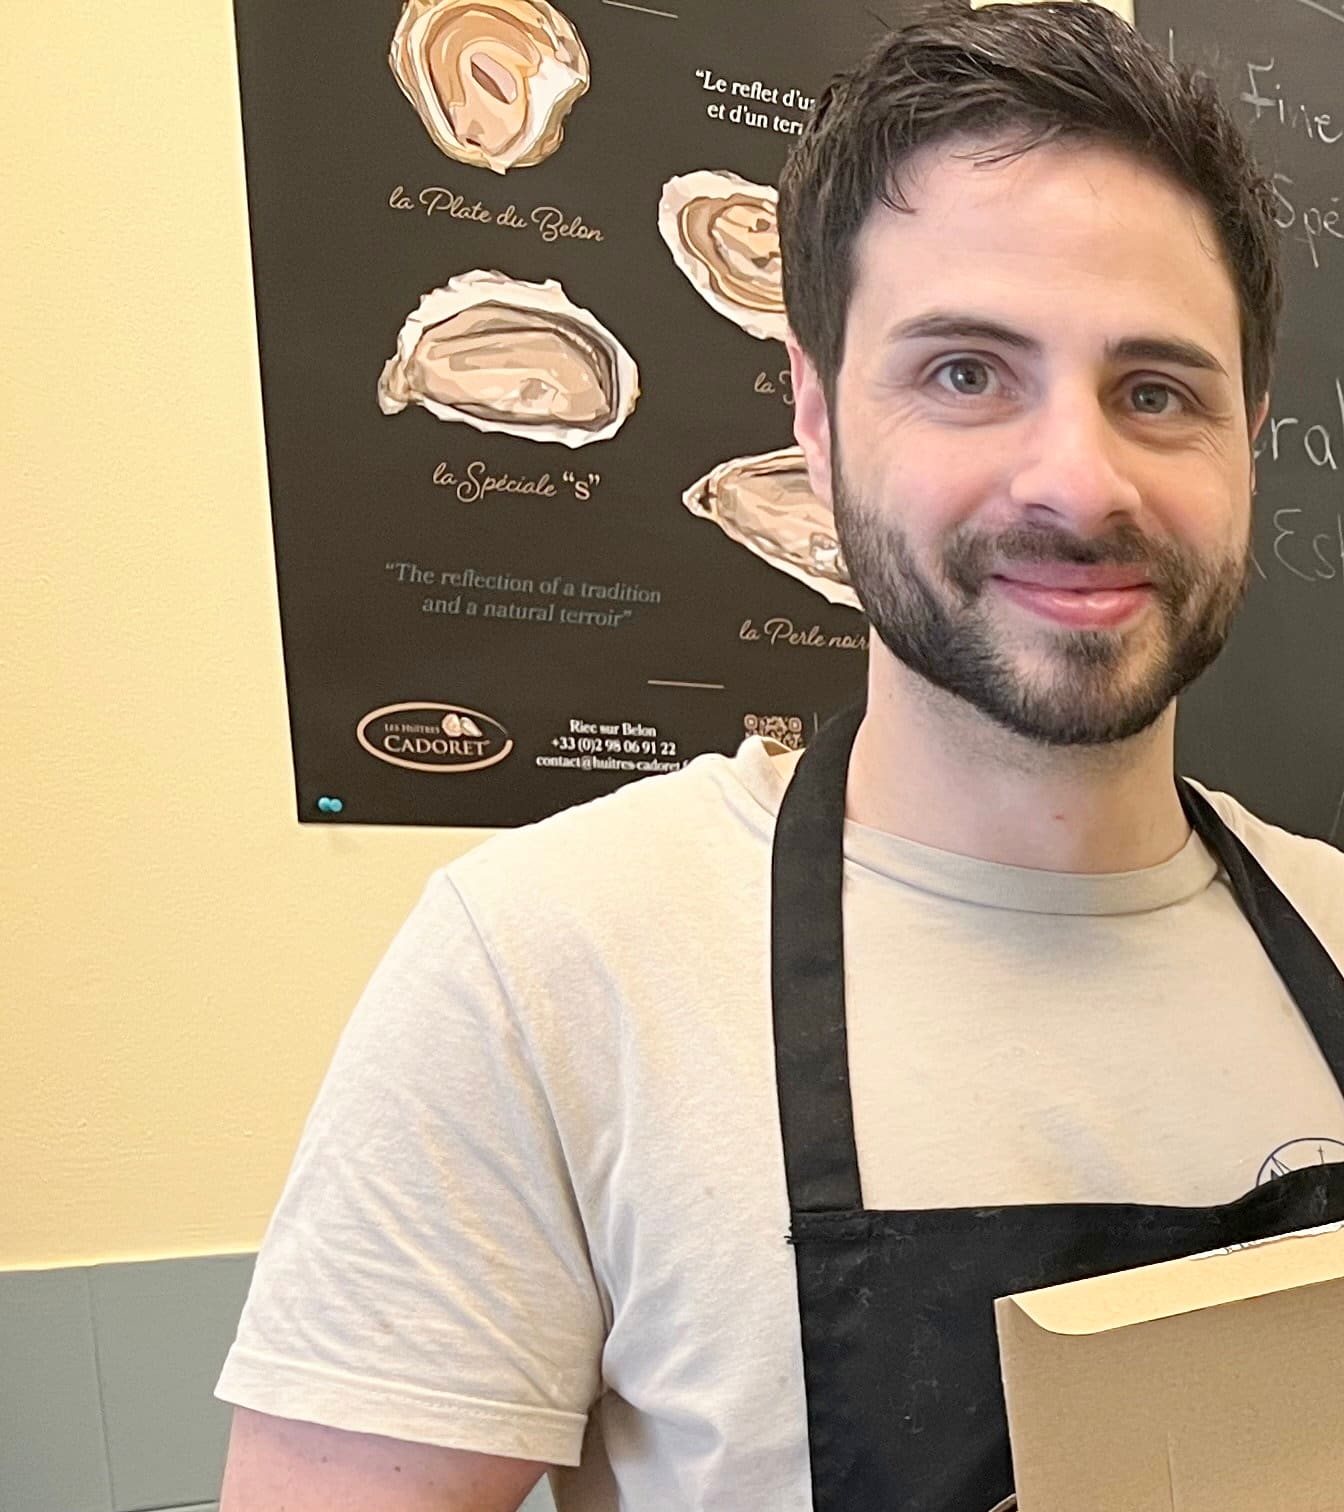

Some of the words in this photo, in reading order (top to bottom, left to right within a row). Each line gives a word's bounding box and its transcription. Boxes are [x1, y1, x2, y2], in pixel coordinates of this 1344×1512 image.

[731, 81, 778, 104] reflet
[1240, 57, 1343, 143] Fine
[707, 104, 726, 120] et
[729, 105, 768, 128] d'un
[389, 186, 415, 209] la
[419, 187, 492, 223] Plate
[496, 205, 527, 229] du
[531, 206, 604, 242] Belon
[754, 372, 776, 394] la
[432, 463, 458, 486] la
[457, 462, 557, 502] Spéciale
[440, 569, 533, 593] reflection
[539, 577, 560, 596] of
[562, 581, 575, 597] a
[580, 582, 661, 604] tradition
[422, 596, 461, 615] and
[466, 602, 478, 616] a
[483, 603, 554, 623] natural
[738, 619, 761, 642] la
[763, 617, 827, 648] Perle
[828, 631, 870, 651] noir
[622, 722, 657, 738] Belon
[384, 734, 490, 757] CADORET
[623, 740, 640, 754] 06
[642, 741, 657, 755] 91
[660, 742, 677, 756] 22
